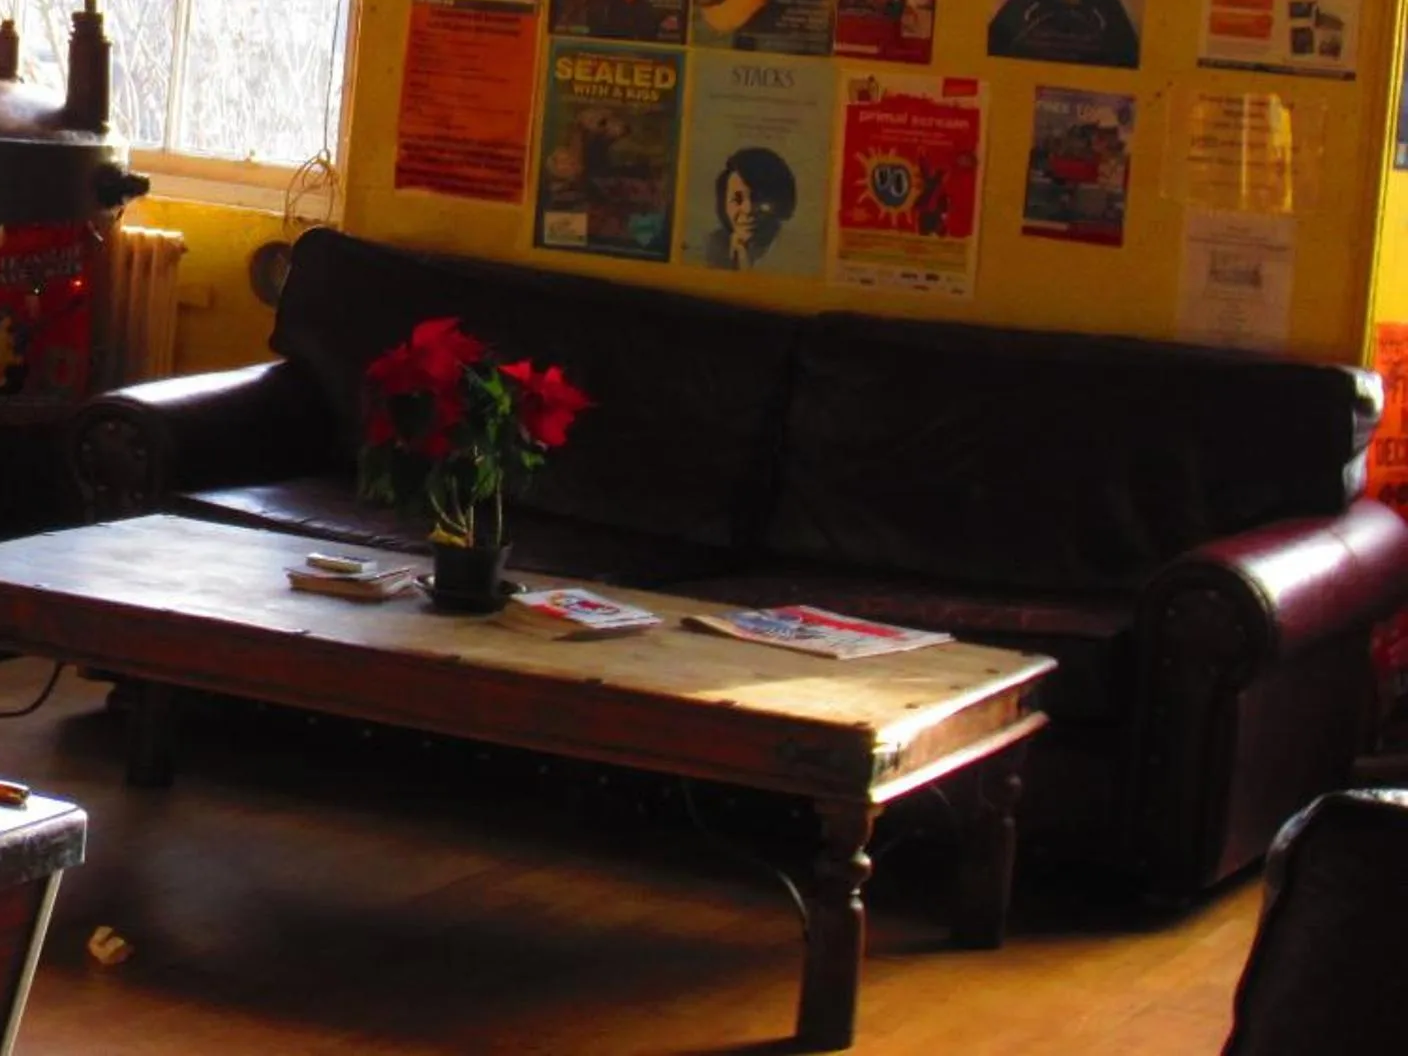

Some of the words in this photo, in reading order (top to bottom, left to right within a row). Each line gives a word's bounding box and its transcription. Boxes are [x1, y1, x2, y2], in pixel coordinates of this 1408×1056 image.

[554, 55, 678, 91] SEALED
[731, 65, 795, 88] STACKS
[572, 84, 609, 99] WITH
[625, 88, 661, 103] KISS
[858, 110, 909, 125] primal
[910, 114, 971, 130] scream
